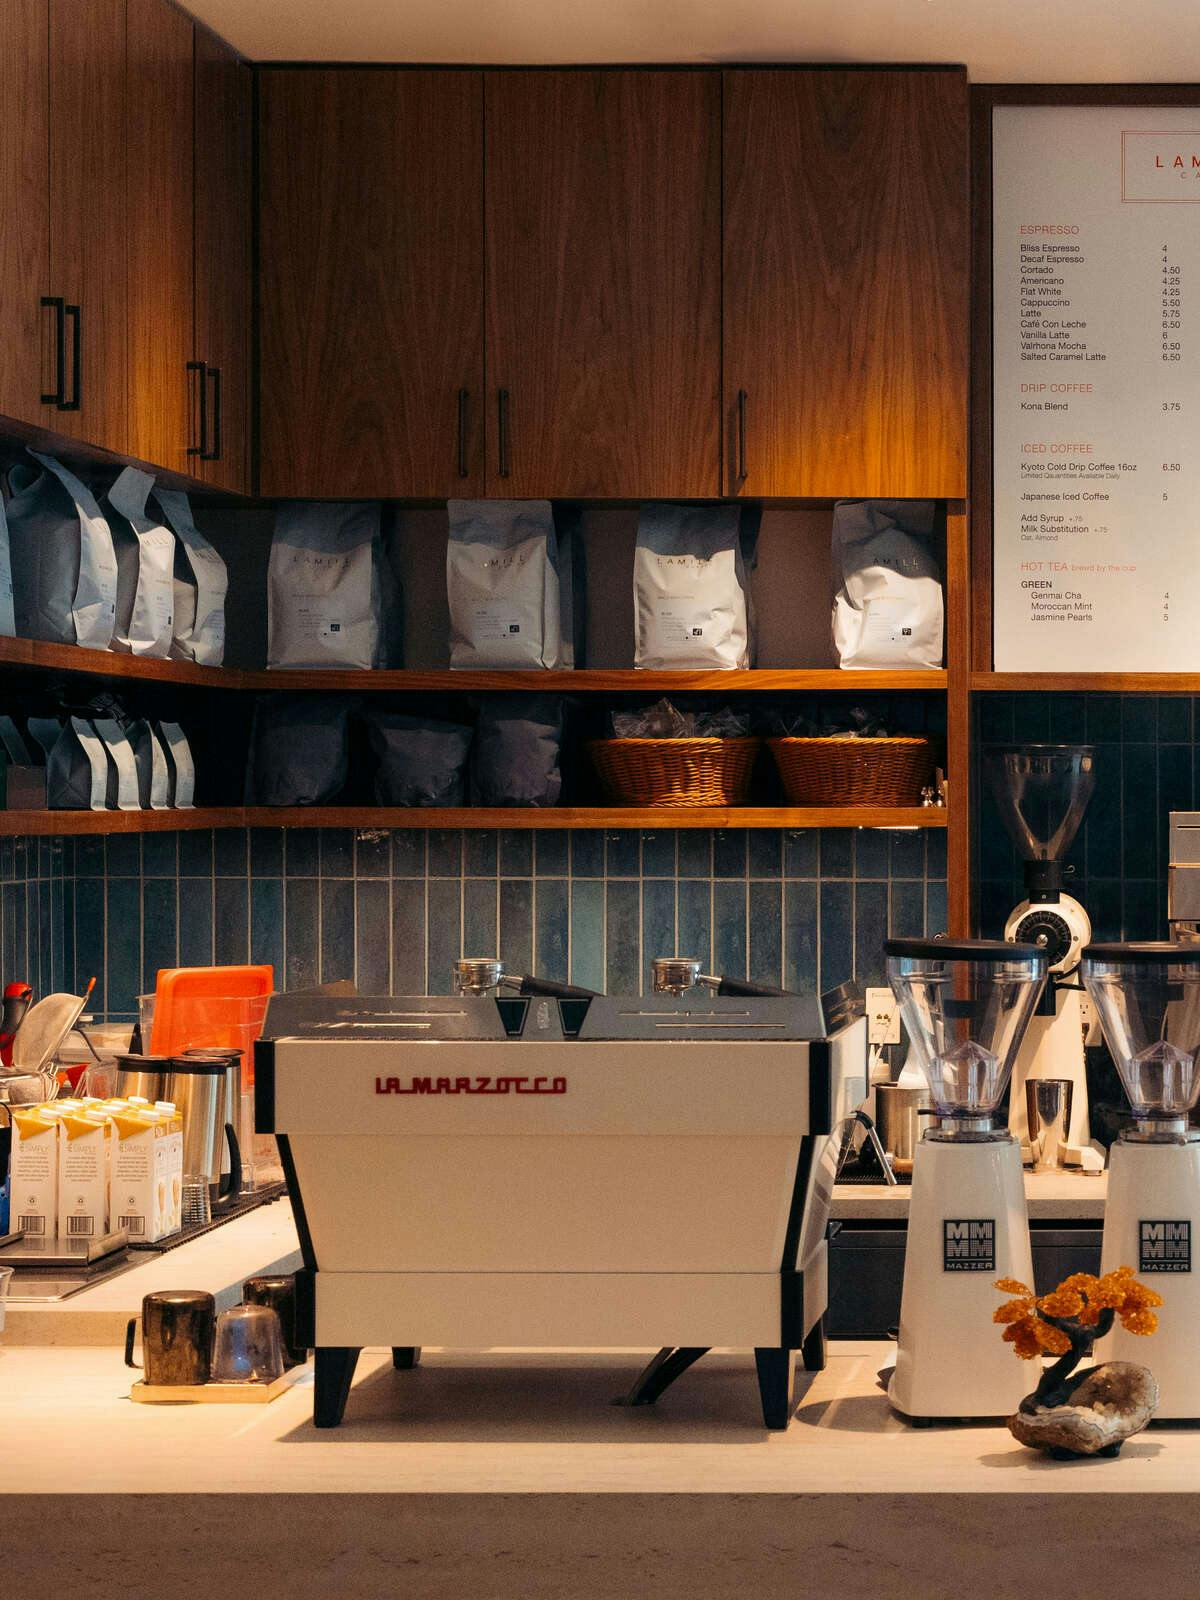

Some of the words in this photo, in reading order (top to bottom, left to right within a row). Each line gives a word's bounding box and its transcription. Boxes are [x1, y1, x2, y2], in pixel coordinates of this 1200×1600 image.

[1020, 225, 1080, 235] ESPRESSO
[1020, 244, 1040, 252] Bliss
[1042, 244, 1080, 253] Espresso
[1020, 255, 1045, 263] Decaf
[1046, 255, 1085, 264] Espresso
[1020, 265, 1054, 274] Cortado
[1162, 267, 1181, 275] 4.50
[1020, 276, 1065, 285] Americano
[1162, 277, 1181, 285] 4.25
[1020, 287, 1036, 296] Flat
[1037, 288, 1062, 296] White
[1162, 288, 1180, 296] 4.25
[1020, 298, 1070, 308] Cappuccino
[1163, 299, 1181, 307] 5.50
[1020, 309, 1042, 318] Latte
[1162, 310, 1181, 318] 5.75
[1020, 320, 1040, 328] Café
[1041, 320, 1059, 329] Con
[1061, 320, 1087, 328] Leche
[1162, 321, 1181, 329] 6.50
[1020, 331, 1047, 339] Vanilla
[1049, 331, 1070, 339] Latte
[1162, 332, 1168, 340] 6
[1020, 342, 1056, 350] Valrhona
[1058, 342, 1087, 350] Mocha
[1162, 343, 1181, 351] 6.50
[1020, 353, 1047, 361] Salted
[1049, 353, 1083, 361] Caramel
[1085, 353, 1106, 361] Latte
[1162, 353, 1181, 361] 6.50
[1021, 384, 1047, 393] DRIP
[1050, 384, 1093, 393] COFFEE
[1021, 402, 1043, 410] Kona
[1044, 402, 1068, 411] Blend
[1163, 403, 1181, 411] 3.75
[1021, 463, 1045, 472] Kyoto
[1047, 463, 1067, 471] Cold
[1069, 463, 1086, 472] Drip
[1088, 463, 1115, 471] Coffee
[1118, 463, 1137, 471] 16oz
[1020, 493, 1061, 502] Japanese
[1062, 493, 1080, 501] Iced
[1082, 493, 1110, 501] Coffee
[1163, 493, 1168, 501] 5
[1021, 581, 1052, 589] GREEN
[376, 1077, 400, 1094] LA
[412, 1077, 566, 1094] MARZOCCO
